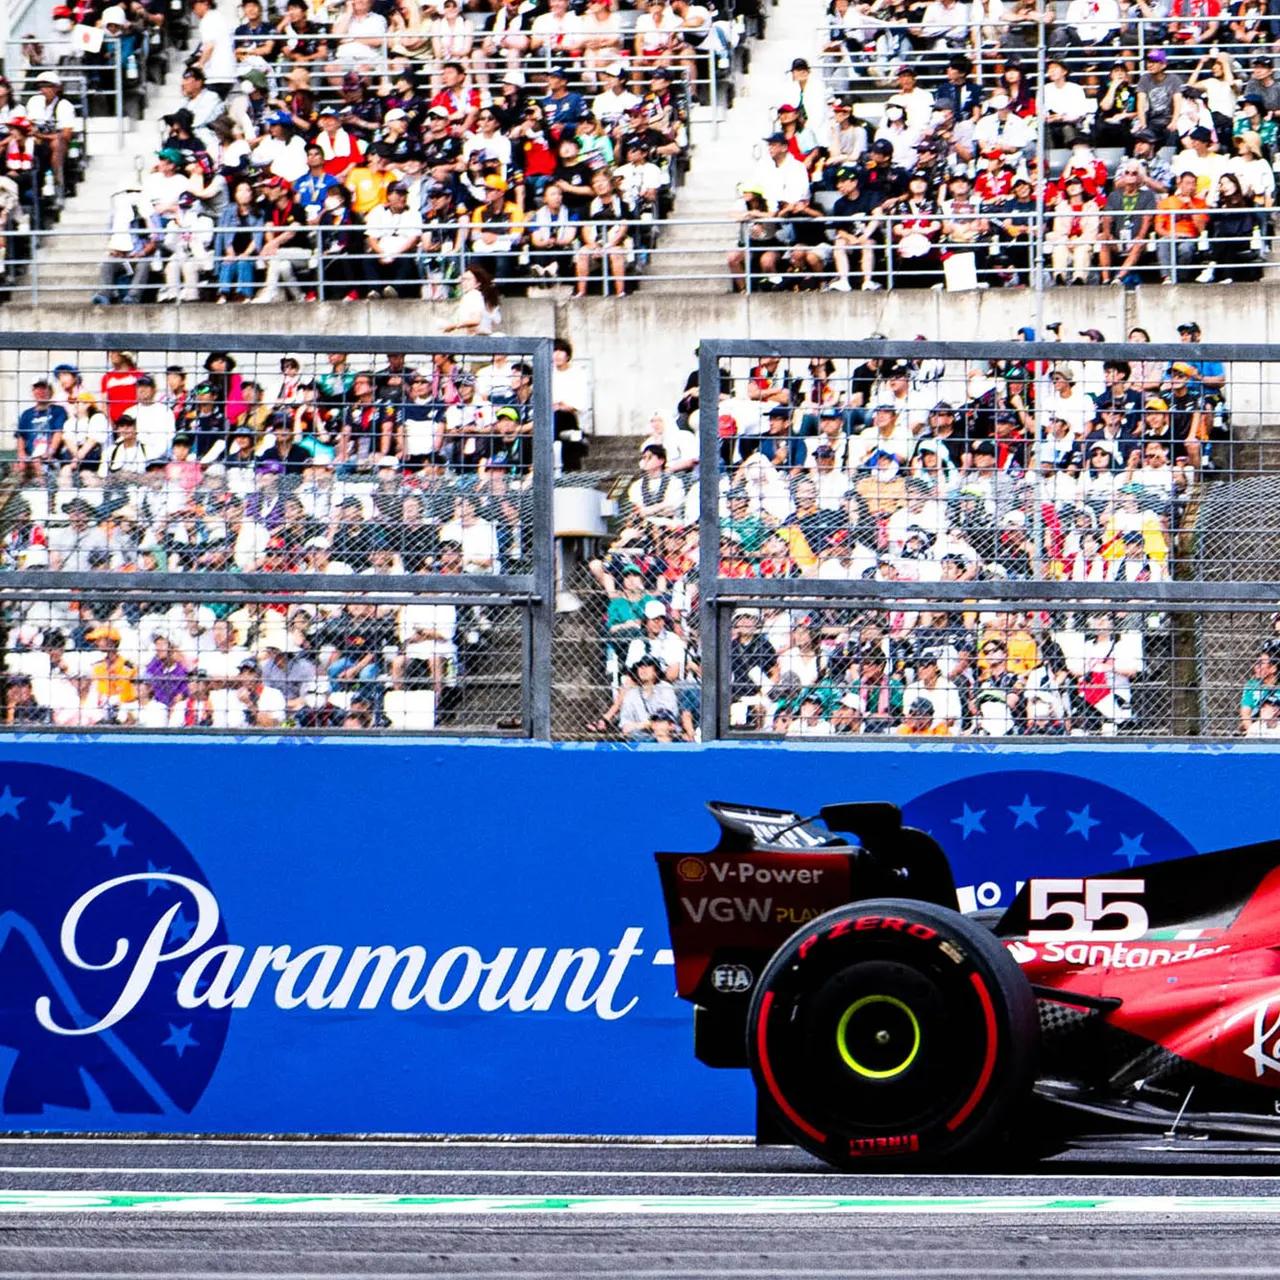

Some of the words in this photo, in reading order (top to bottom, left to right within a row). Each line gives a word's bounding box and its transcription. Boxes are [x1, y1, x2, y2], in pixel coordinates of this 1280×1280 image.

[711, 862, 823, 884] V-Power
[680, 898, 773, 923] VGW
[1029, 879, 1149, 942] 55
[827, 916, 938, 940] ZERO
[36, 873, 676, 1034] Paramount
[1042, 942, 1231, 968] Santander
